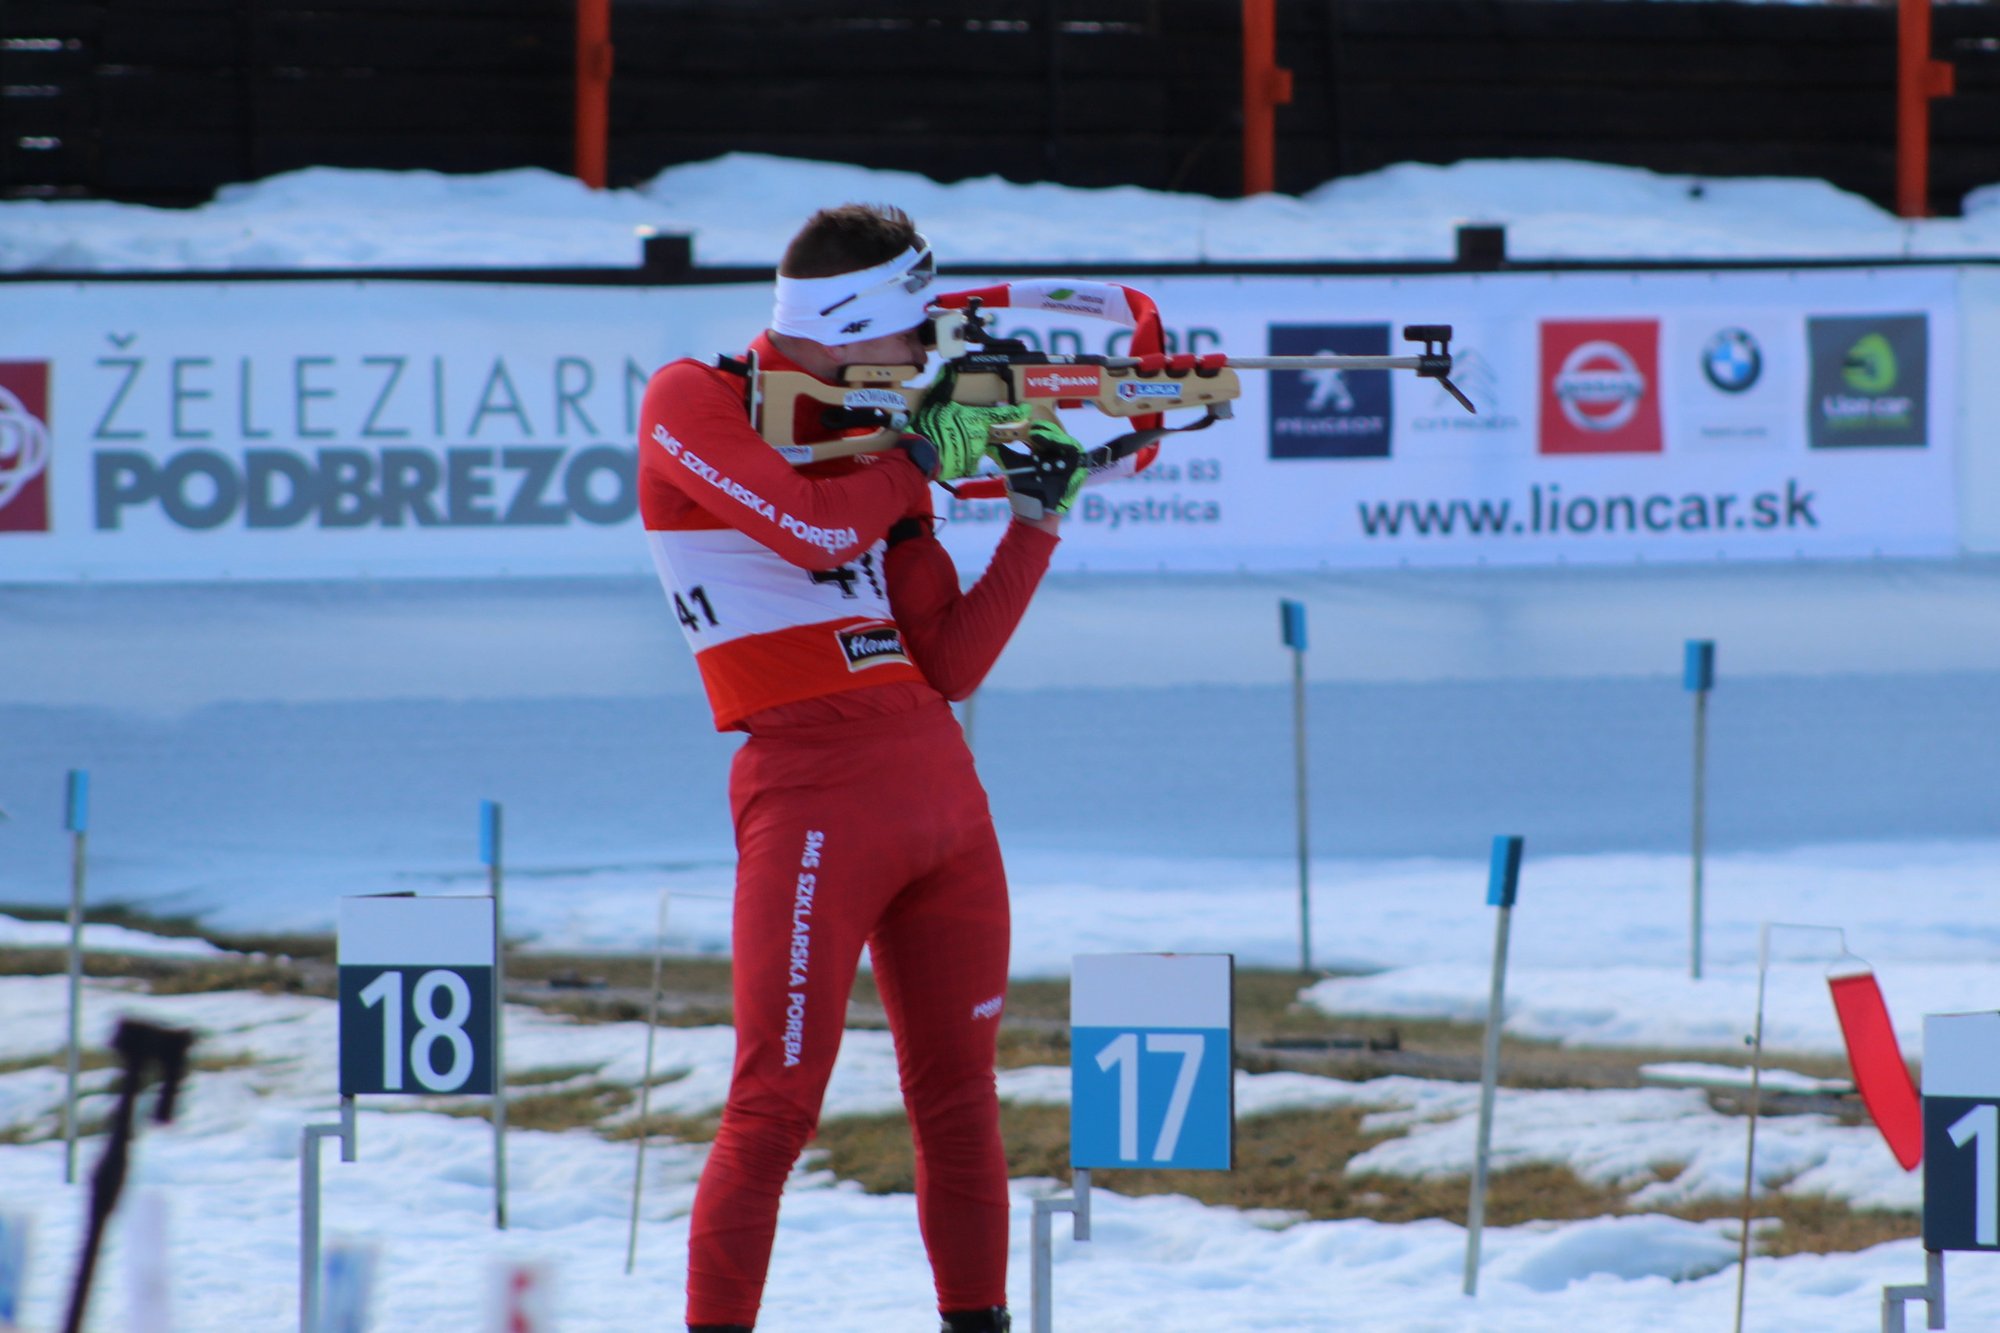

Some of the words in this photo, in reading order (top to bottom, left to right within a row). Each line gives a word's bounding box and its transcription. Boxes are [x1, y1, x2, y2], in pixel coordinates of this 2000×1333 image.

[94, 446, 641, 531] PODBREZO
[651, 423, 683, 457] SMS
[678, 451, 776, 523] SZKLARSKA
[1082, 494, 1221, 528] Bystrica
[1358, 478, 1818, 538] www.lioncar.sk
[674, 584, 720, 632] 41
[801, 829, 825, 868] SMS
[788, 872, 817, 987] SZKLARSKA
[359, 969, 474, 1092] 18
[1095, 1033, 1205, 1162] 17
